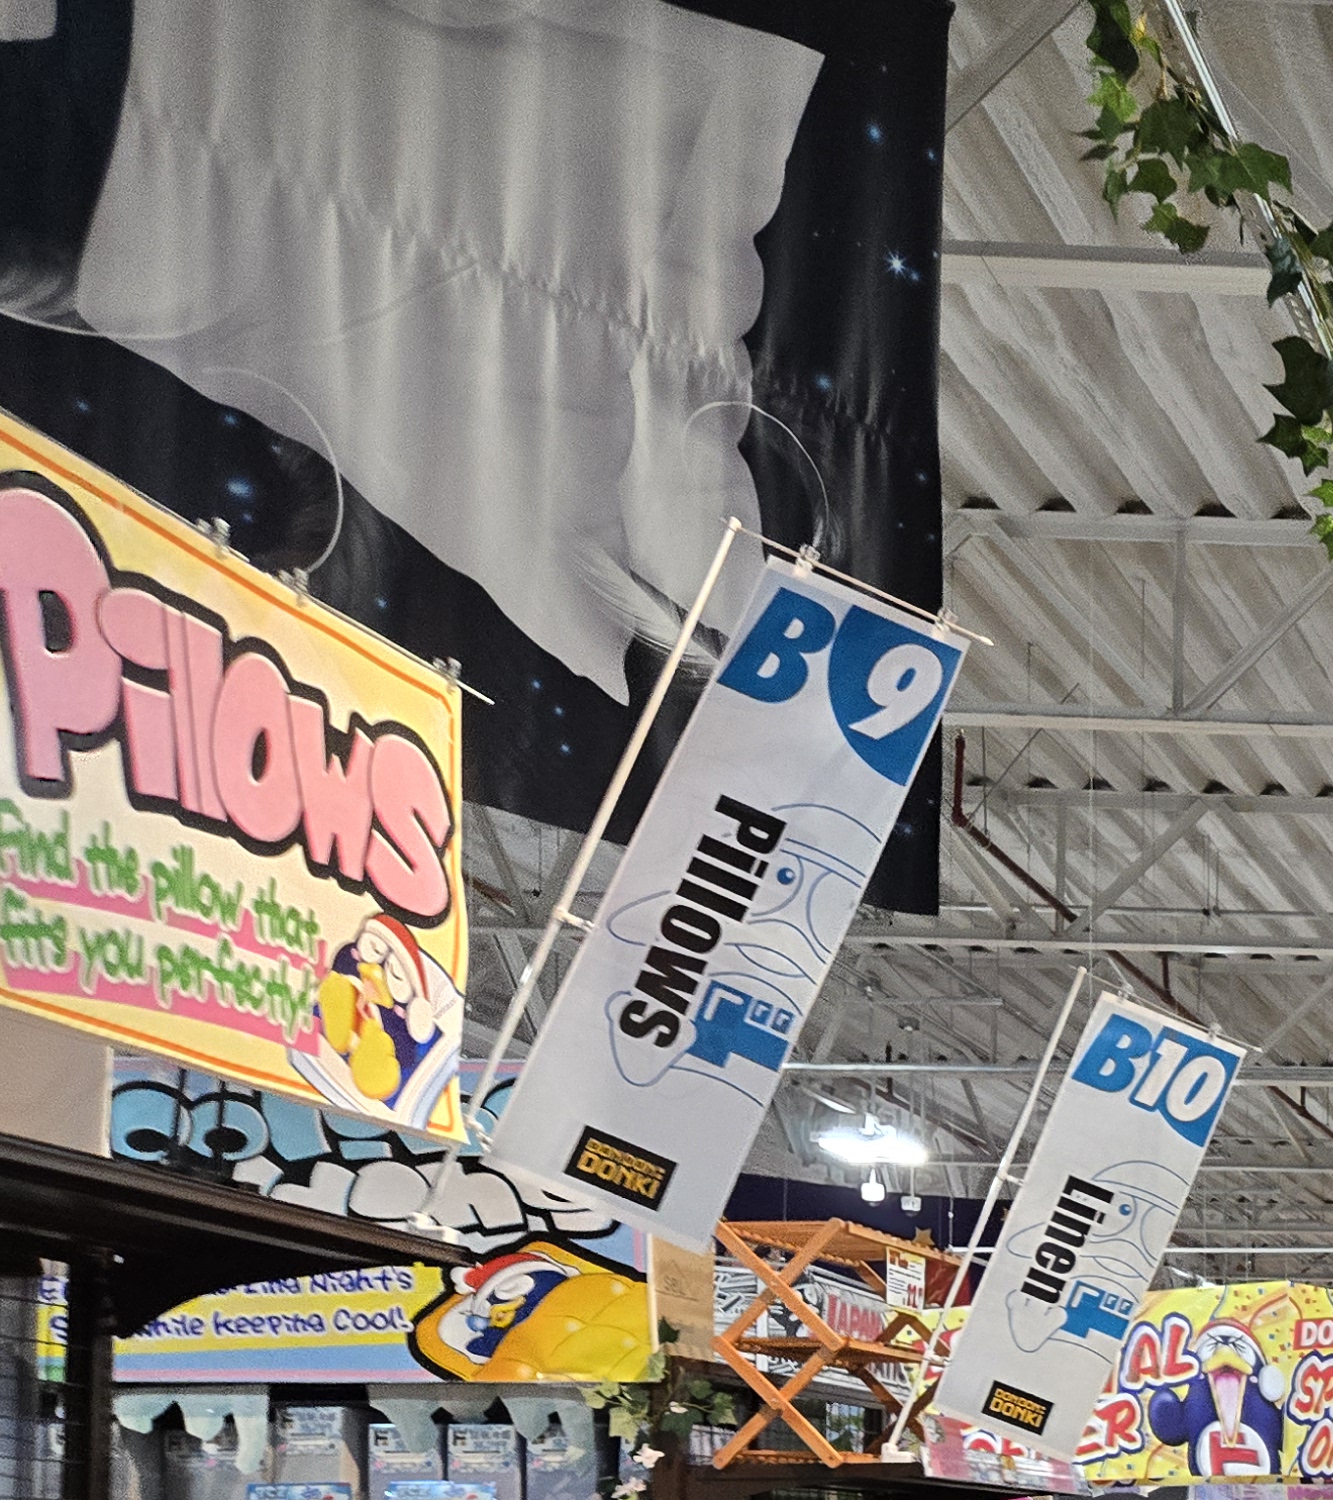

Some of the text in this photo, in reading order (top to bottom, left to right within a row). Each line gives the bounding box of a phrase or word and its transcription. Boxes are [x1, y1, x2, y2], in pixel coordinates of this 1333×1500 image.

[0, 472, 452, 925] Pillows
[84, 820, 140, 899] the
[152, 844, 244, 930] pillow
[252, 877, 320, 962] that
[618, 795, 788, 1049] Pillows
[79, 926, 146, 992] you
[1072, 1014, 1226, 1122] B10
[576, 1151, 660, 1200] DONKI
[1020, 1175, 1115, 1305] Linen
[212, 1311, 325, 1335] keeping
[333, 1307, 414, 1334] Cool!
[987, 1398, 1044, 1428] DONKI
